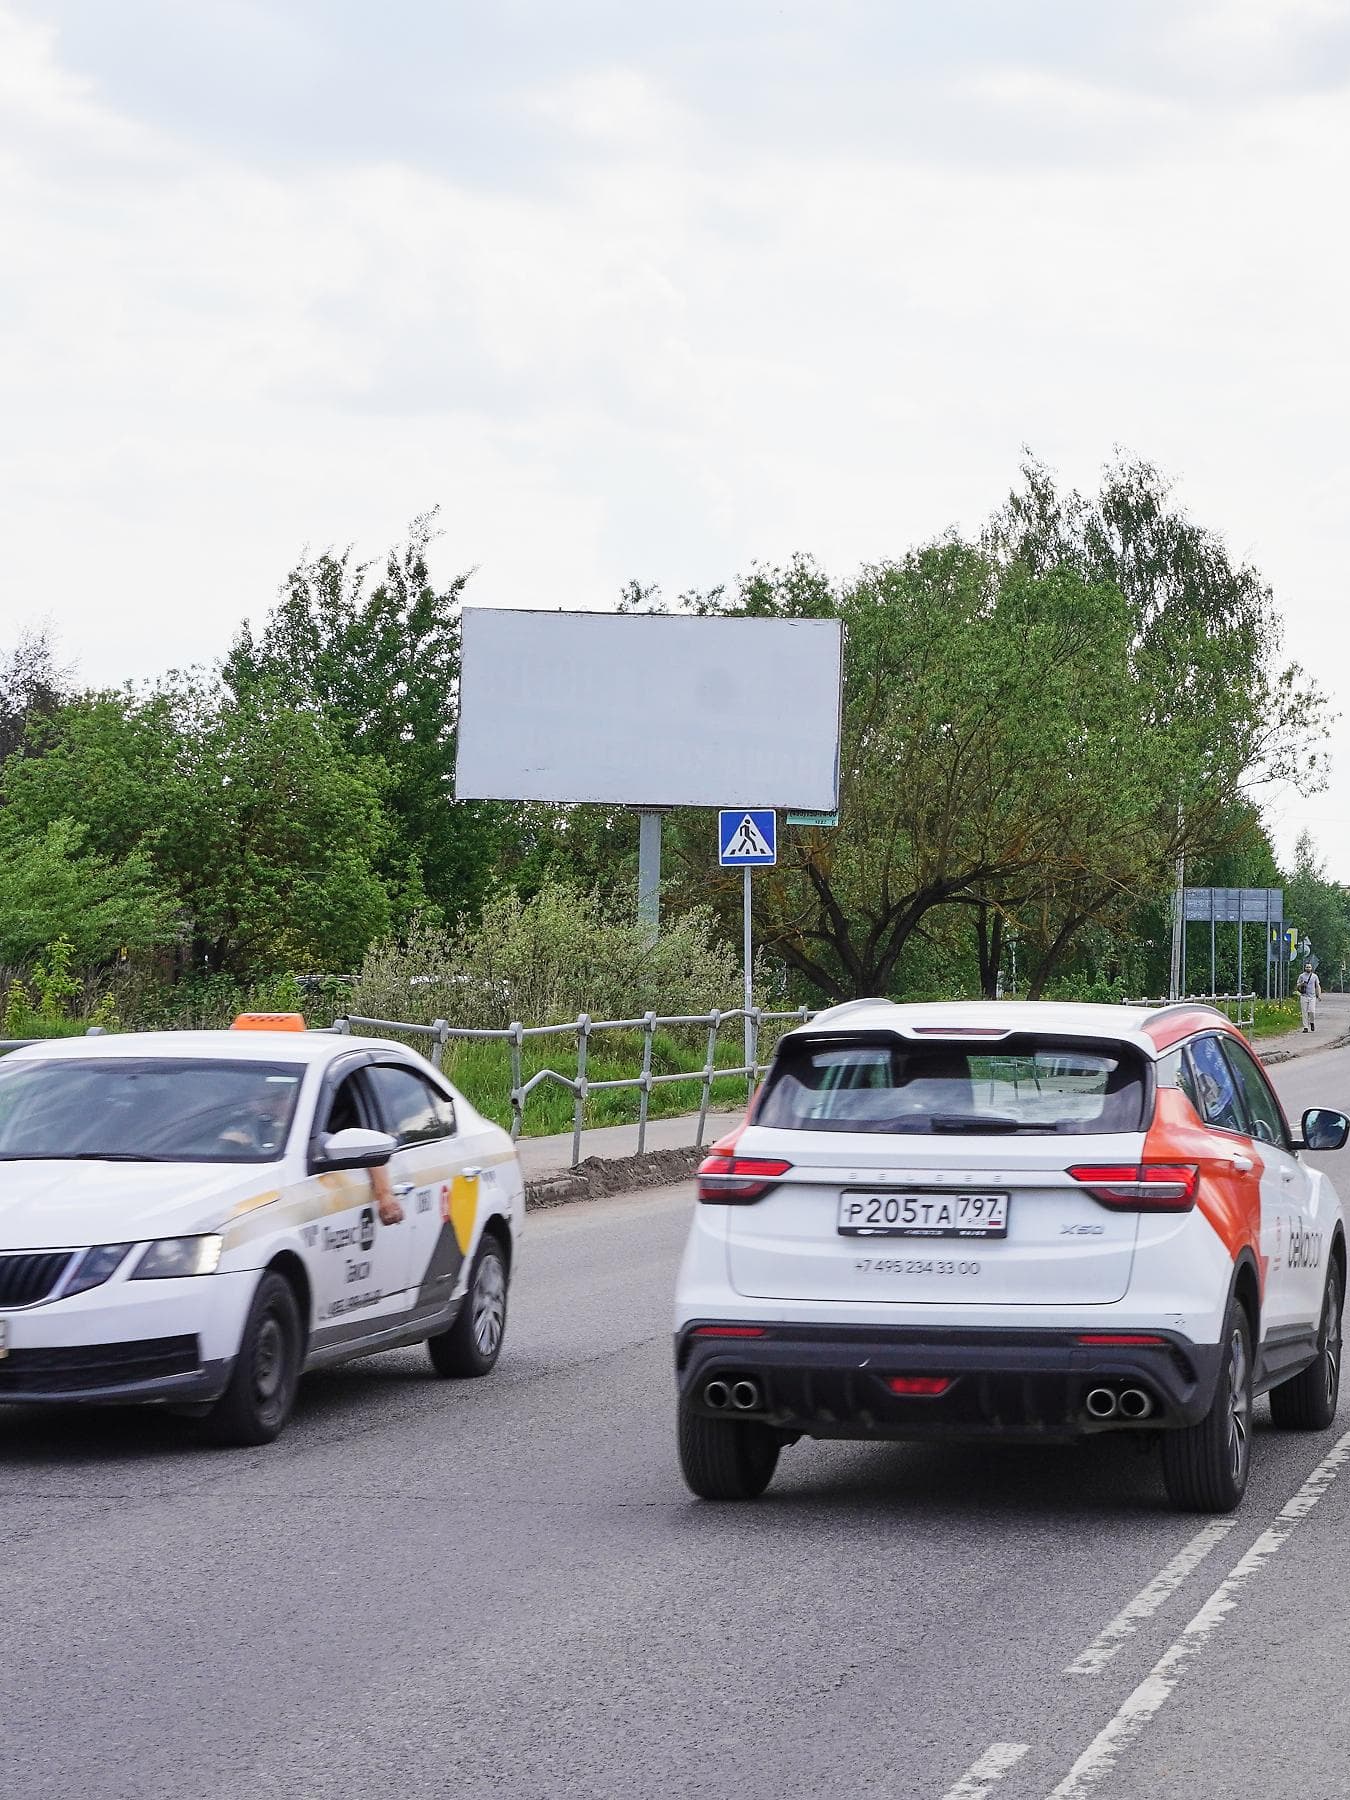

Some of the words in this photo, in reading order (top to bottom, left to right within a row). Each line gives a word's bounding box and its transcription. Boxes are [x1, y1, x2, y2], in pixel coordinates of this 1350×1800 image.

[958, 1198, 999, 1217] 797
[855, 1260, 872, 1272] +7
[874, 1260, 903, 1273] 495
[905, 1261, 933, 1274] 234
[936, 1261, 955, 1275] 33
[958, 1262, 981, 1275] 00
